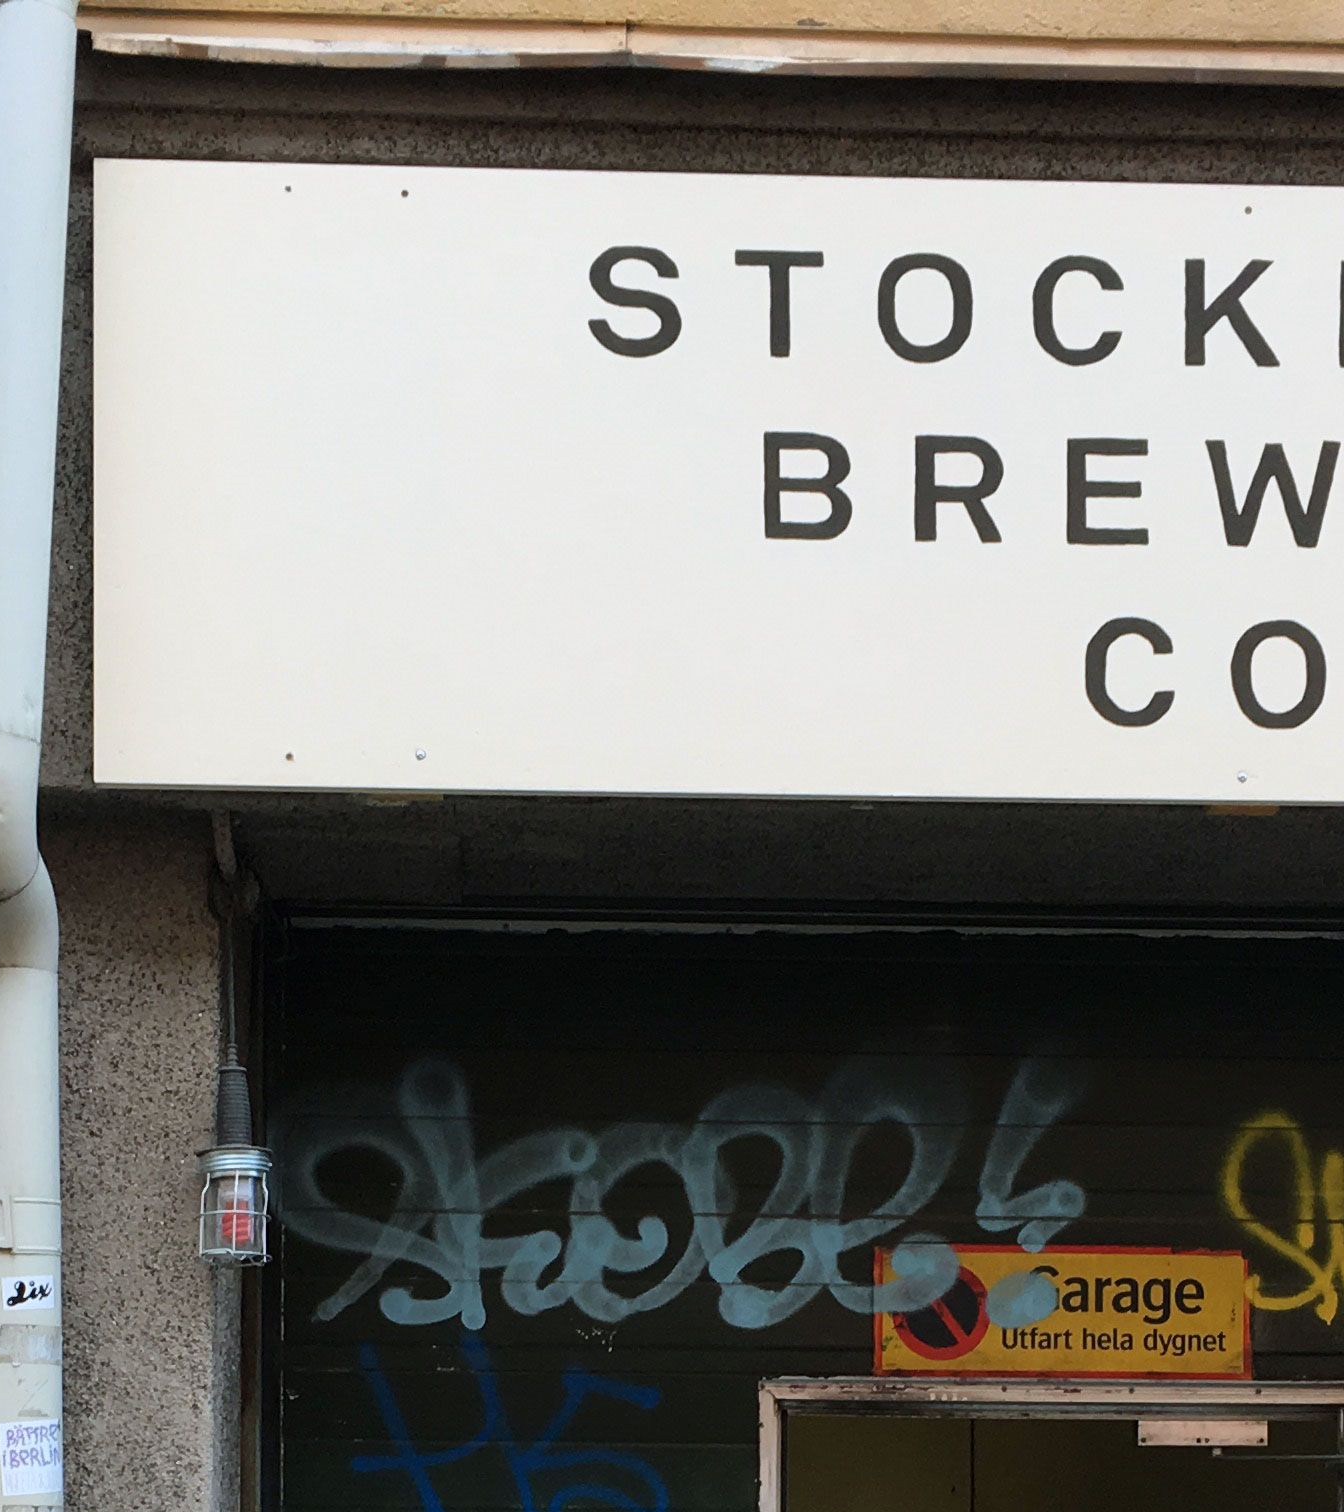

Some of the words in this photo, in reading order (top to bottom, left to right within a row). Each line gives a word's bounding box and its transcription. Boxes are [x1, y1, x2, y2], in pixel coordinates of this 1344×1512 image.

[1001, 1328, 1073, 1350] Utfart
[1082, 1328, 1134, 1351] hela
[1143, 1328, 1227, 1357] dygnet
